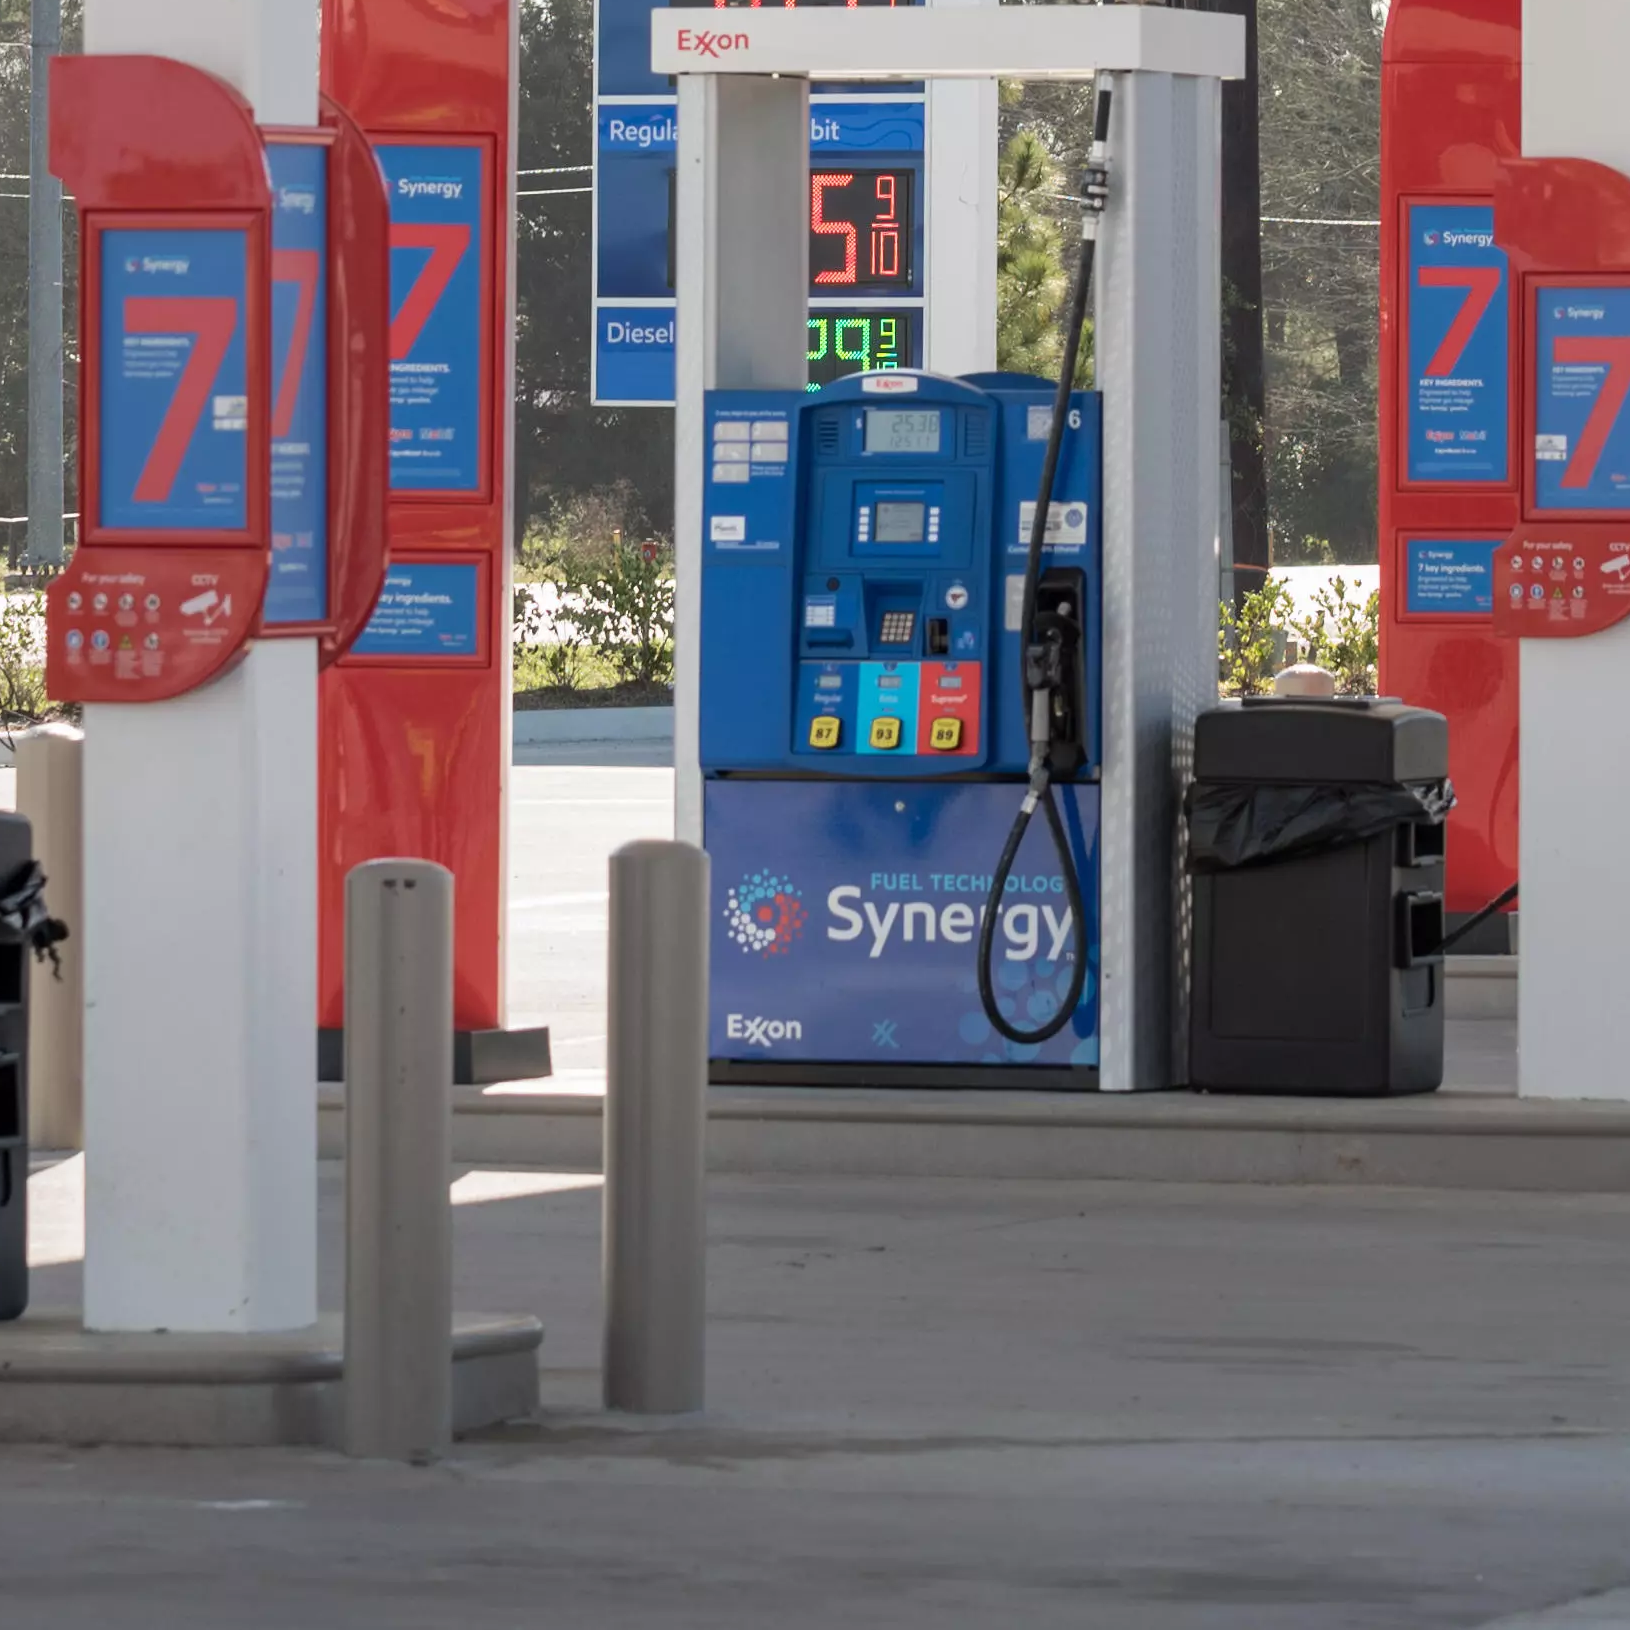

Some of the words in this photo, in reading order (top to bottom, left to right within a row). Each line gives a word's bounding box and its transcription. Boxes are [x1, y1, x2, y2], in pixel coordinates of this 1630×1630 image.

[677, 29, 749, 59] Exxon
[610, 120, 678, 146] Regul
[810, 119, 839, 142] bit
[397, 178, 462, 198] Synergy
[812, 175, 856, 283] 5
[1442, 231, 1494, 247] Synergy
[389, 223, 470, 358] 7
[607, 321, 673, 346] Diesel
[1418, 266, 1501, 376] 7
[123, 297, 237, 503] 7
[1068, 409, 1081, 430] 6
[816, 728, 833, 740] 87
[876, 728, 893, 740] 93
[936, 729, 954, 741] 89
[871, 873, 922, 891] FUEL
[726, 1014, 802, 1047] Exxon
